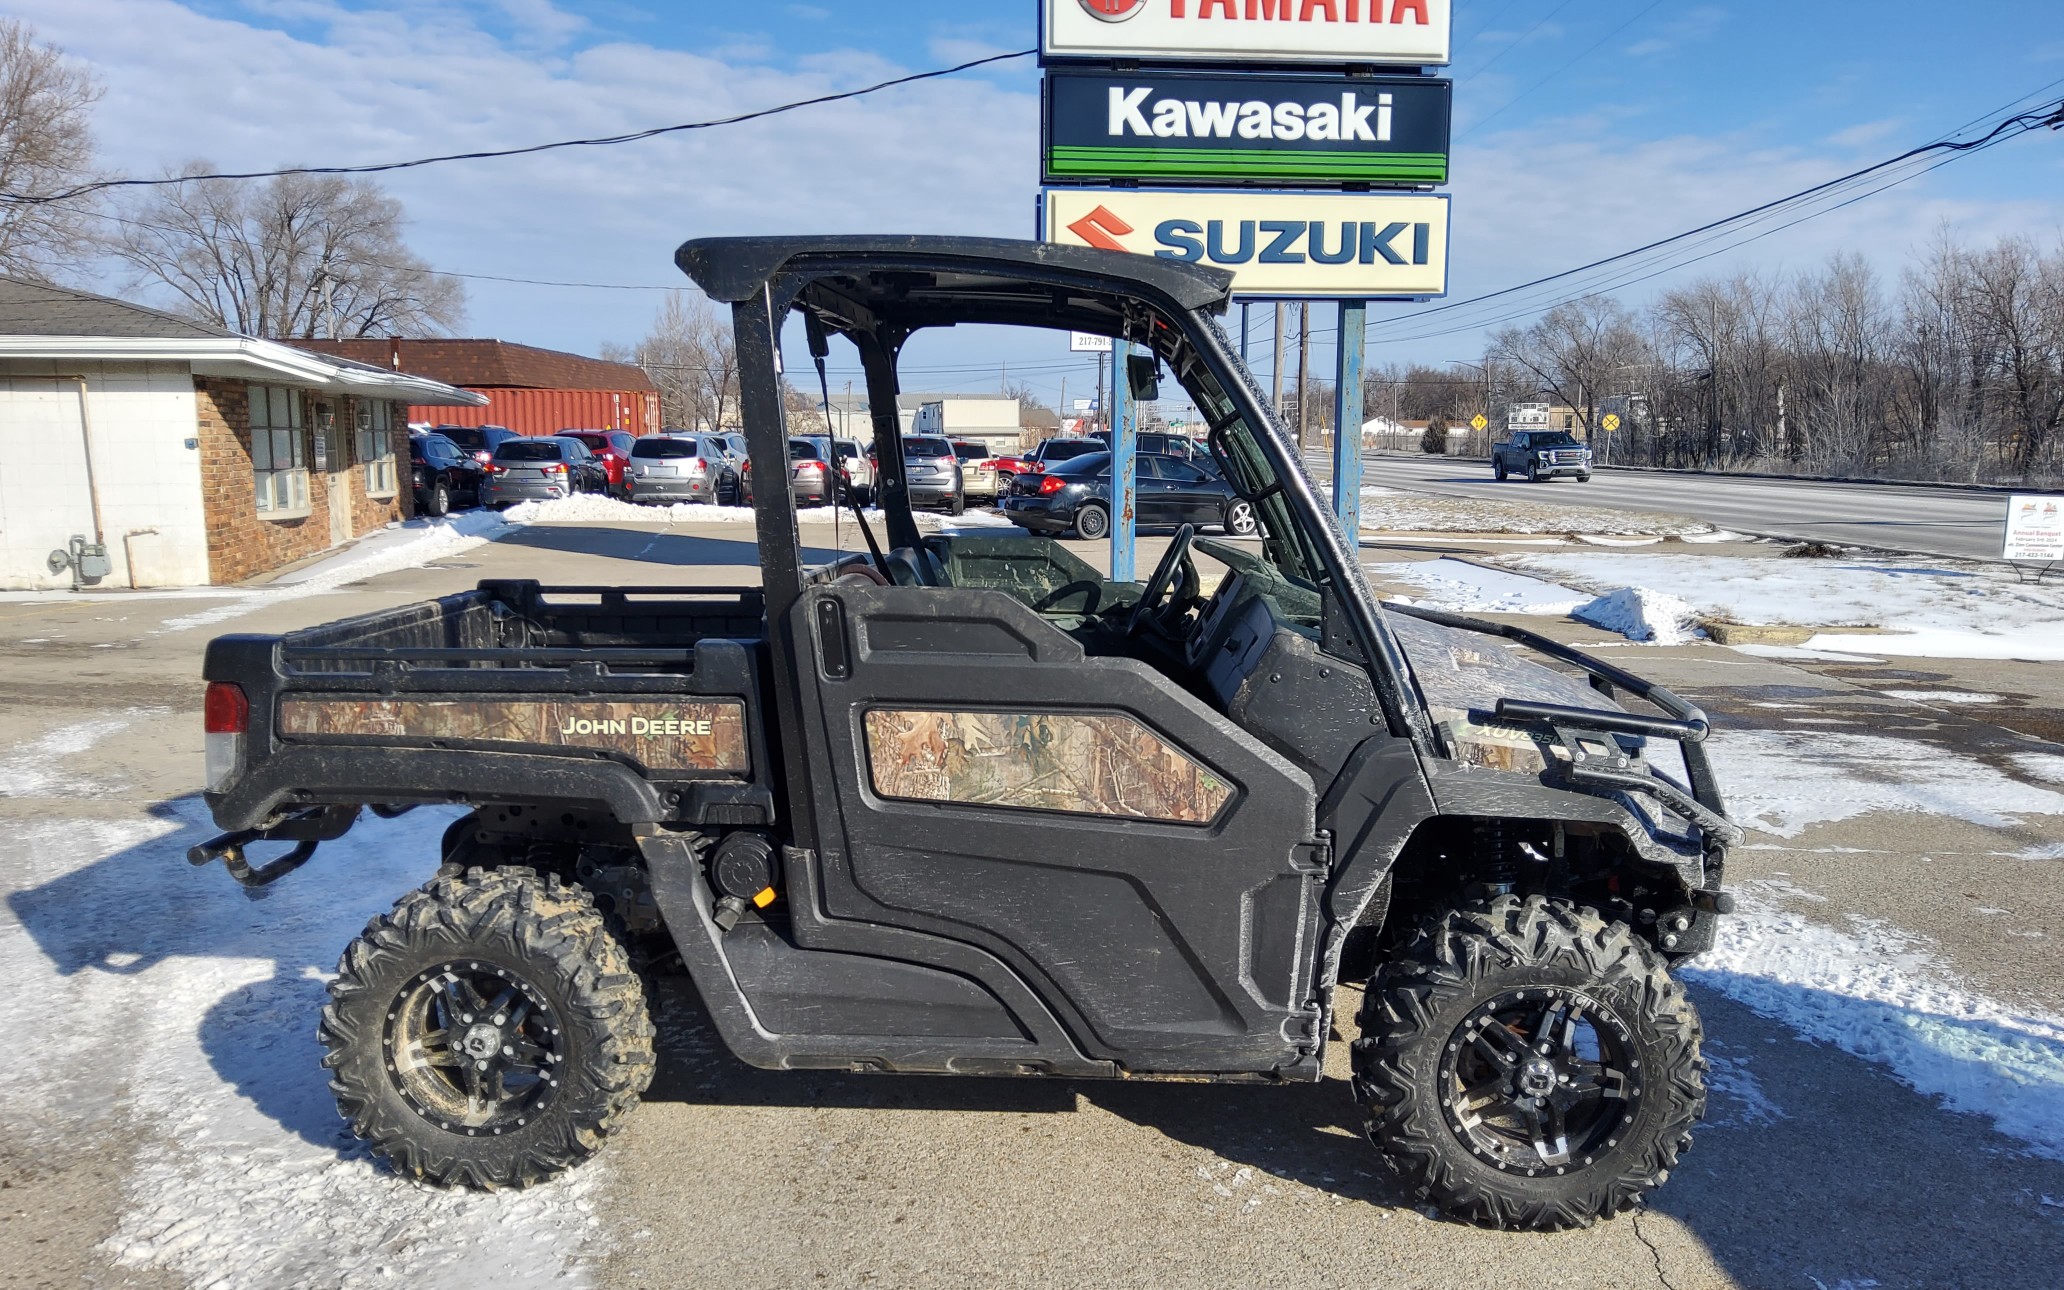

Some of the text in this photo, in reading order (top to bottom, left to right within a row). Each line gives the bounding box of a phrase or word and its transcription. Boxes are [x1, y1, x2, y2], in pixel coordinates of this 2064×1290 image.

[1108, 86, 1393, 141] Kawasaki
[1154, 219, 1430, 266] SUZUKI
[562, 716, 711, 735] JOHN DEERE
